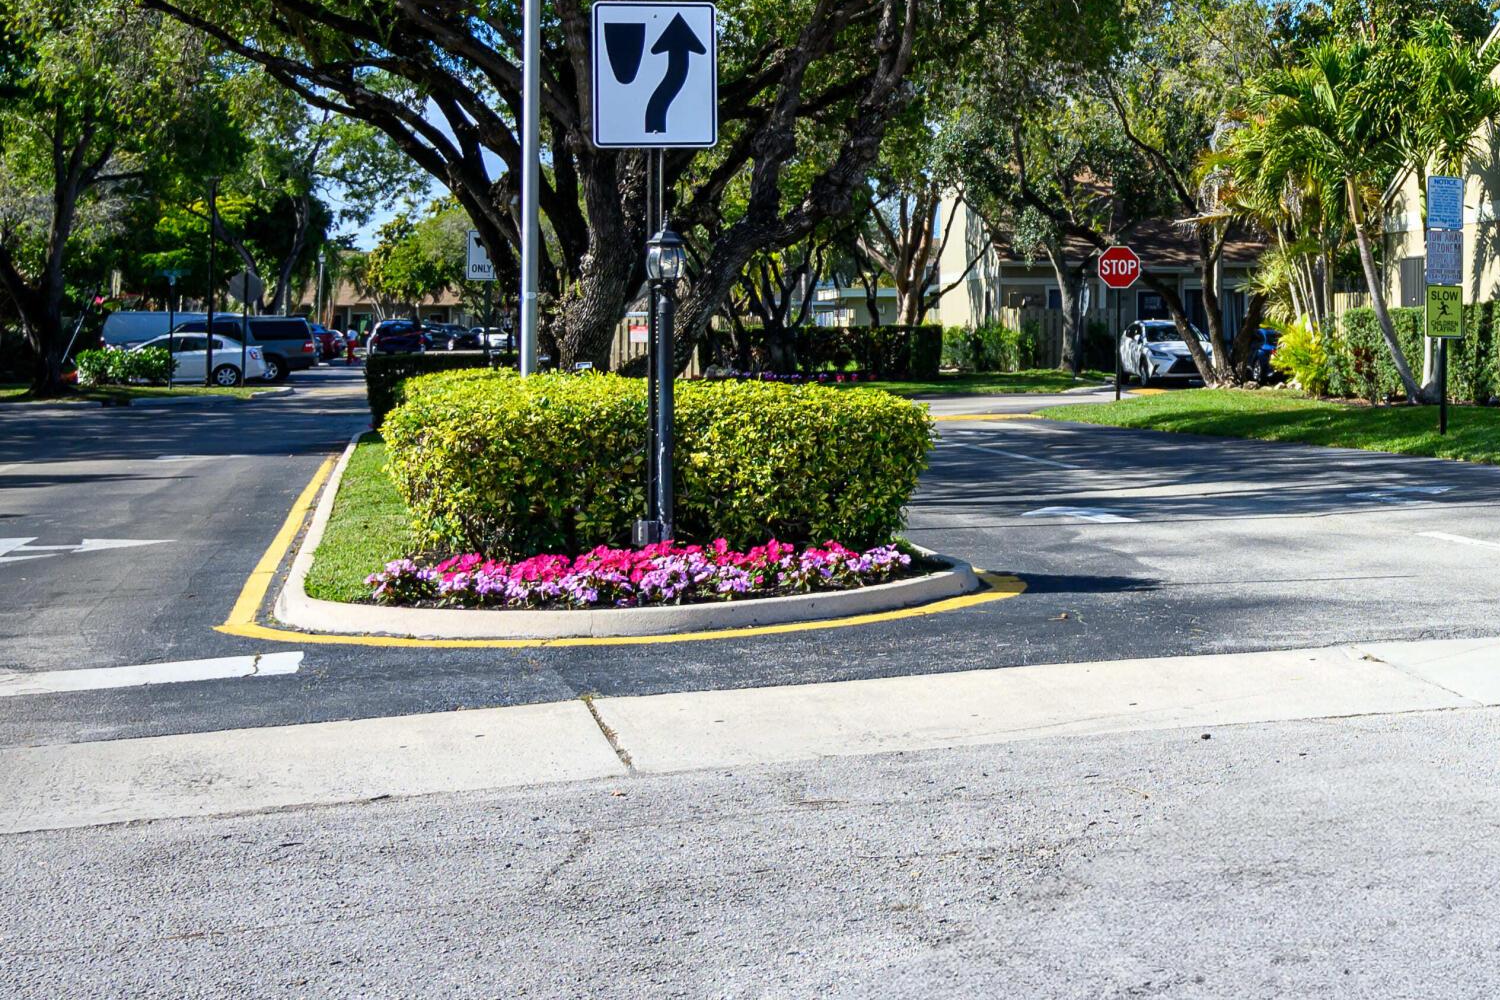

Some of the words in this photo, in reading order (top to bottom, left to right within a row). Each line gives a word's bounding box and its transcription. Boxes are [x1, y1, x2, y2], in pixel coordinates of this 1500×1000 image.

[1434, 178, 1458, 186] NOTICE
[471, 263, 492, 273] ONLY
[1101, 259, 1137, 275] STOP
[1431, 290, 1459, 301] SLOW
